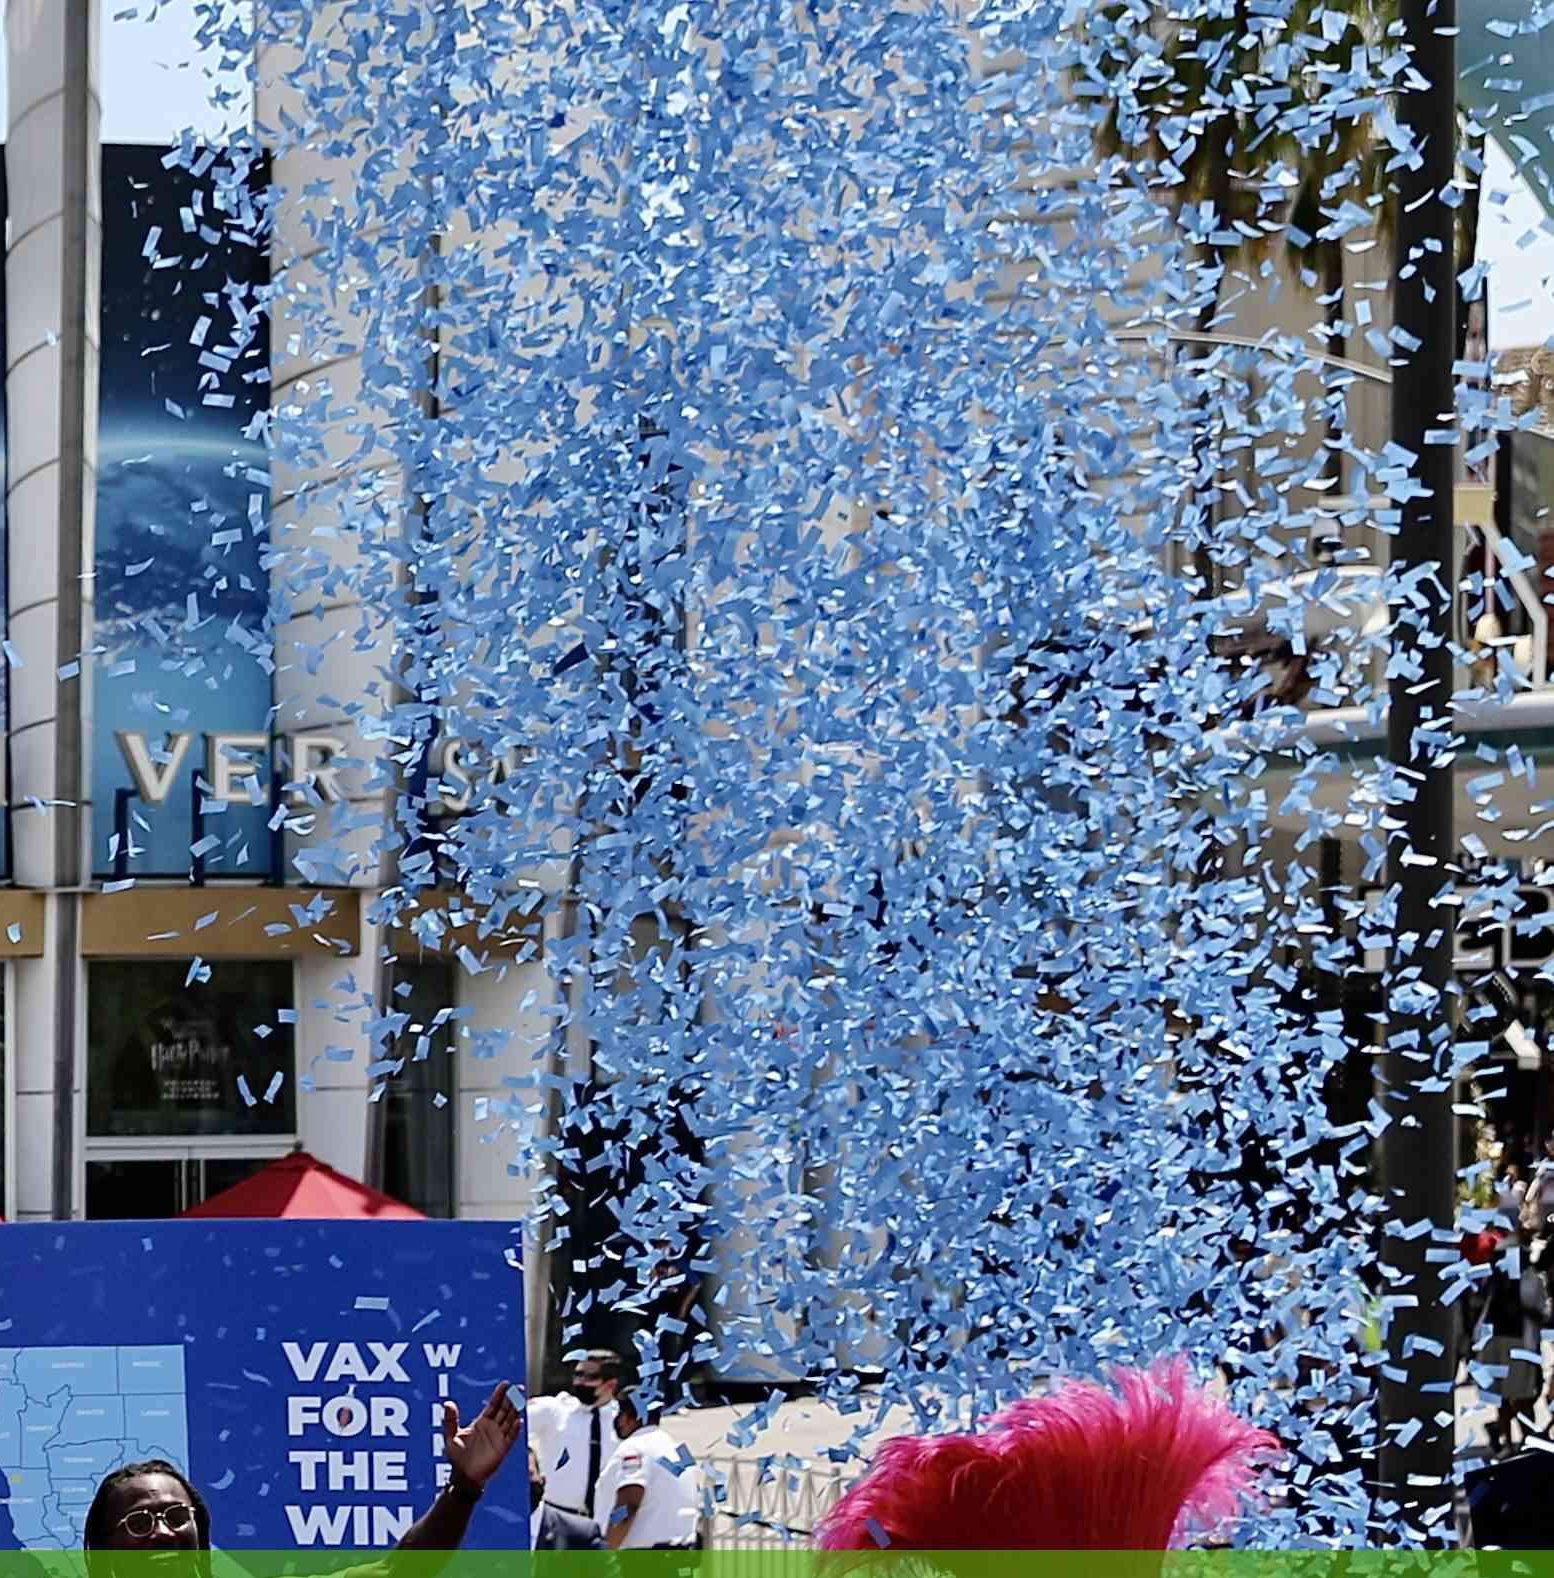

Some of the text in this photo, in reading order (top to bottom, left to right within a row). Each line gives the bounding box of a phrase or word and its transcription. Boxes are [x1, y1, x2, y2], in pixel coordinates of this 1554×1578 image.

[281, 1342, 411, 1382] VAX
[287, 1386, 410, 1436] FOR
[288, 1451, 408, 1491] THE
[284, 1505, 413, 1545] WIN
